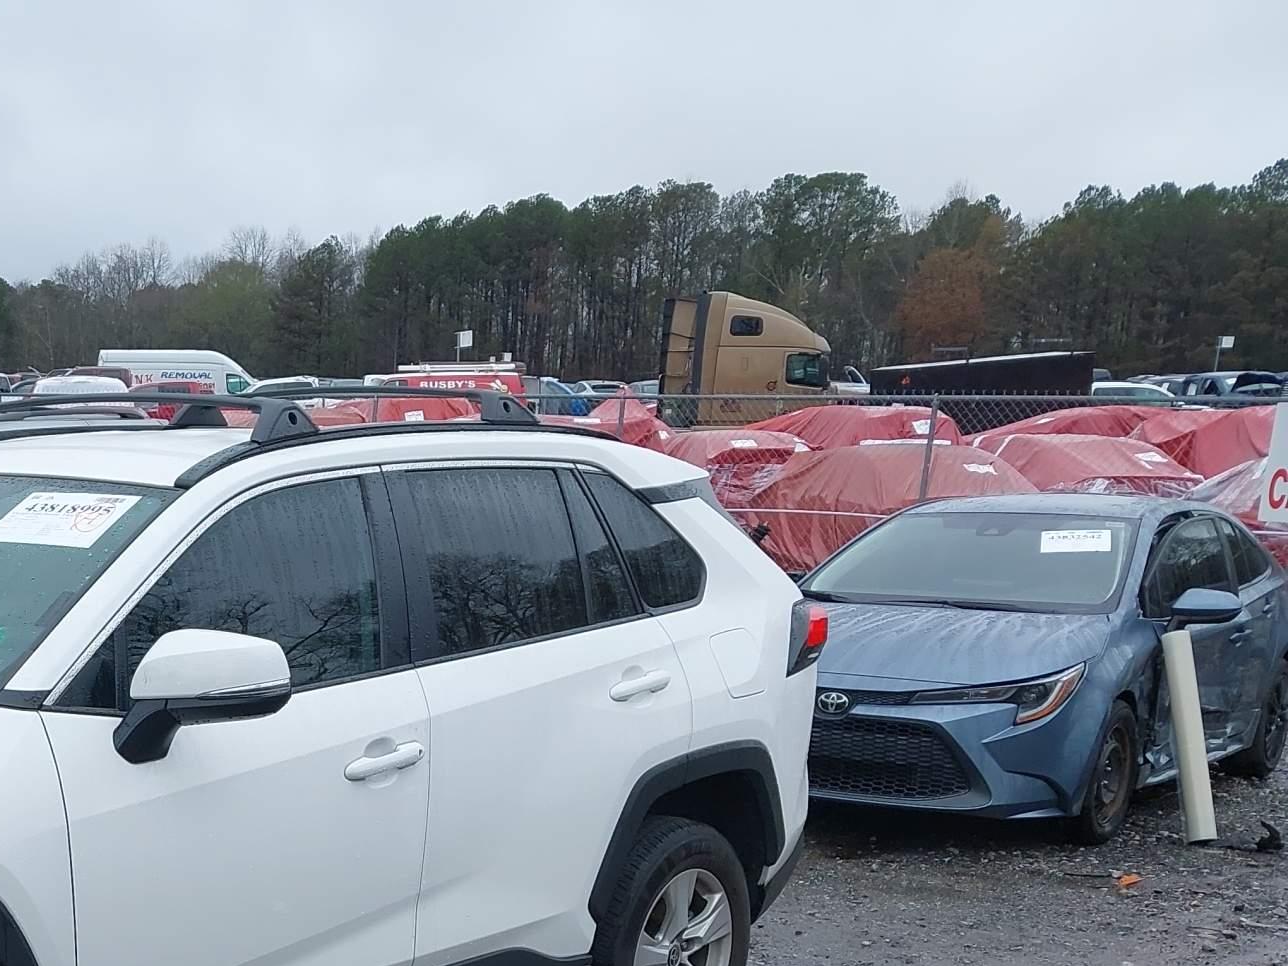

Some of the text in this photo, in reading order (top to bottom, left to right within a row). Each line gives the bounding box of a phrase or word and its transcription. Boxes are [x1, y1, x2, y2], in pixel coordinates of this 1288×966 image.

[160, 371, 213, 379] REMOVAL
[419, 380, 476, 388] BUSBY'S
[25, 502, 116, 515] 43818995
